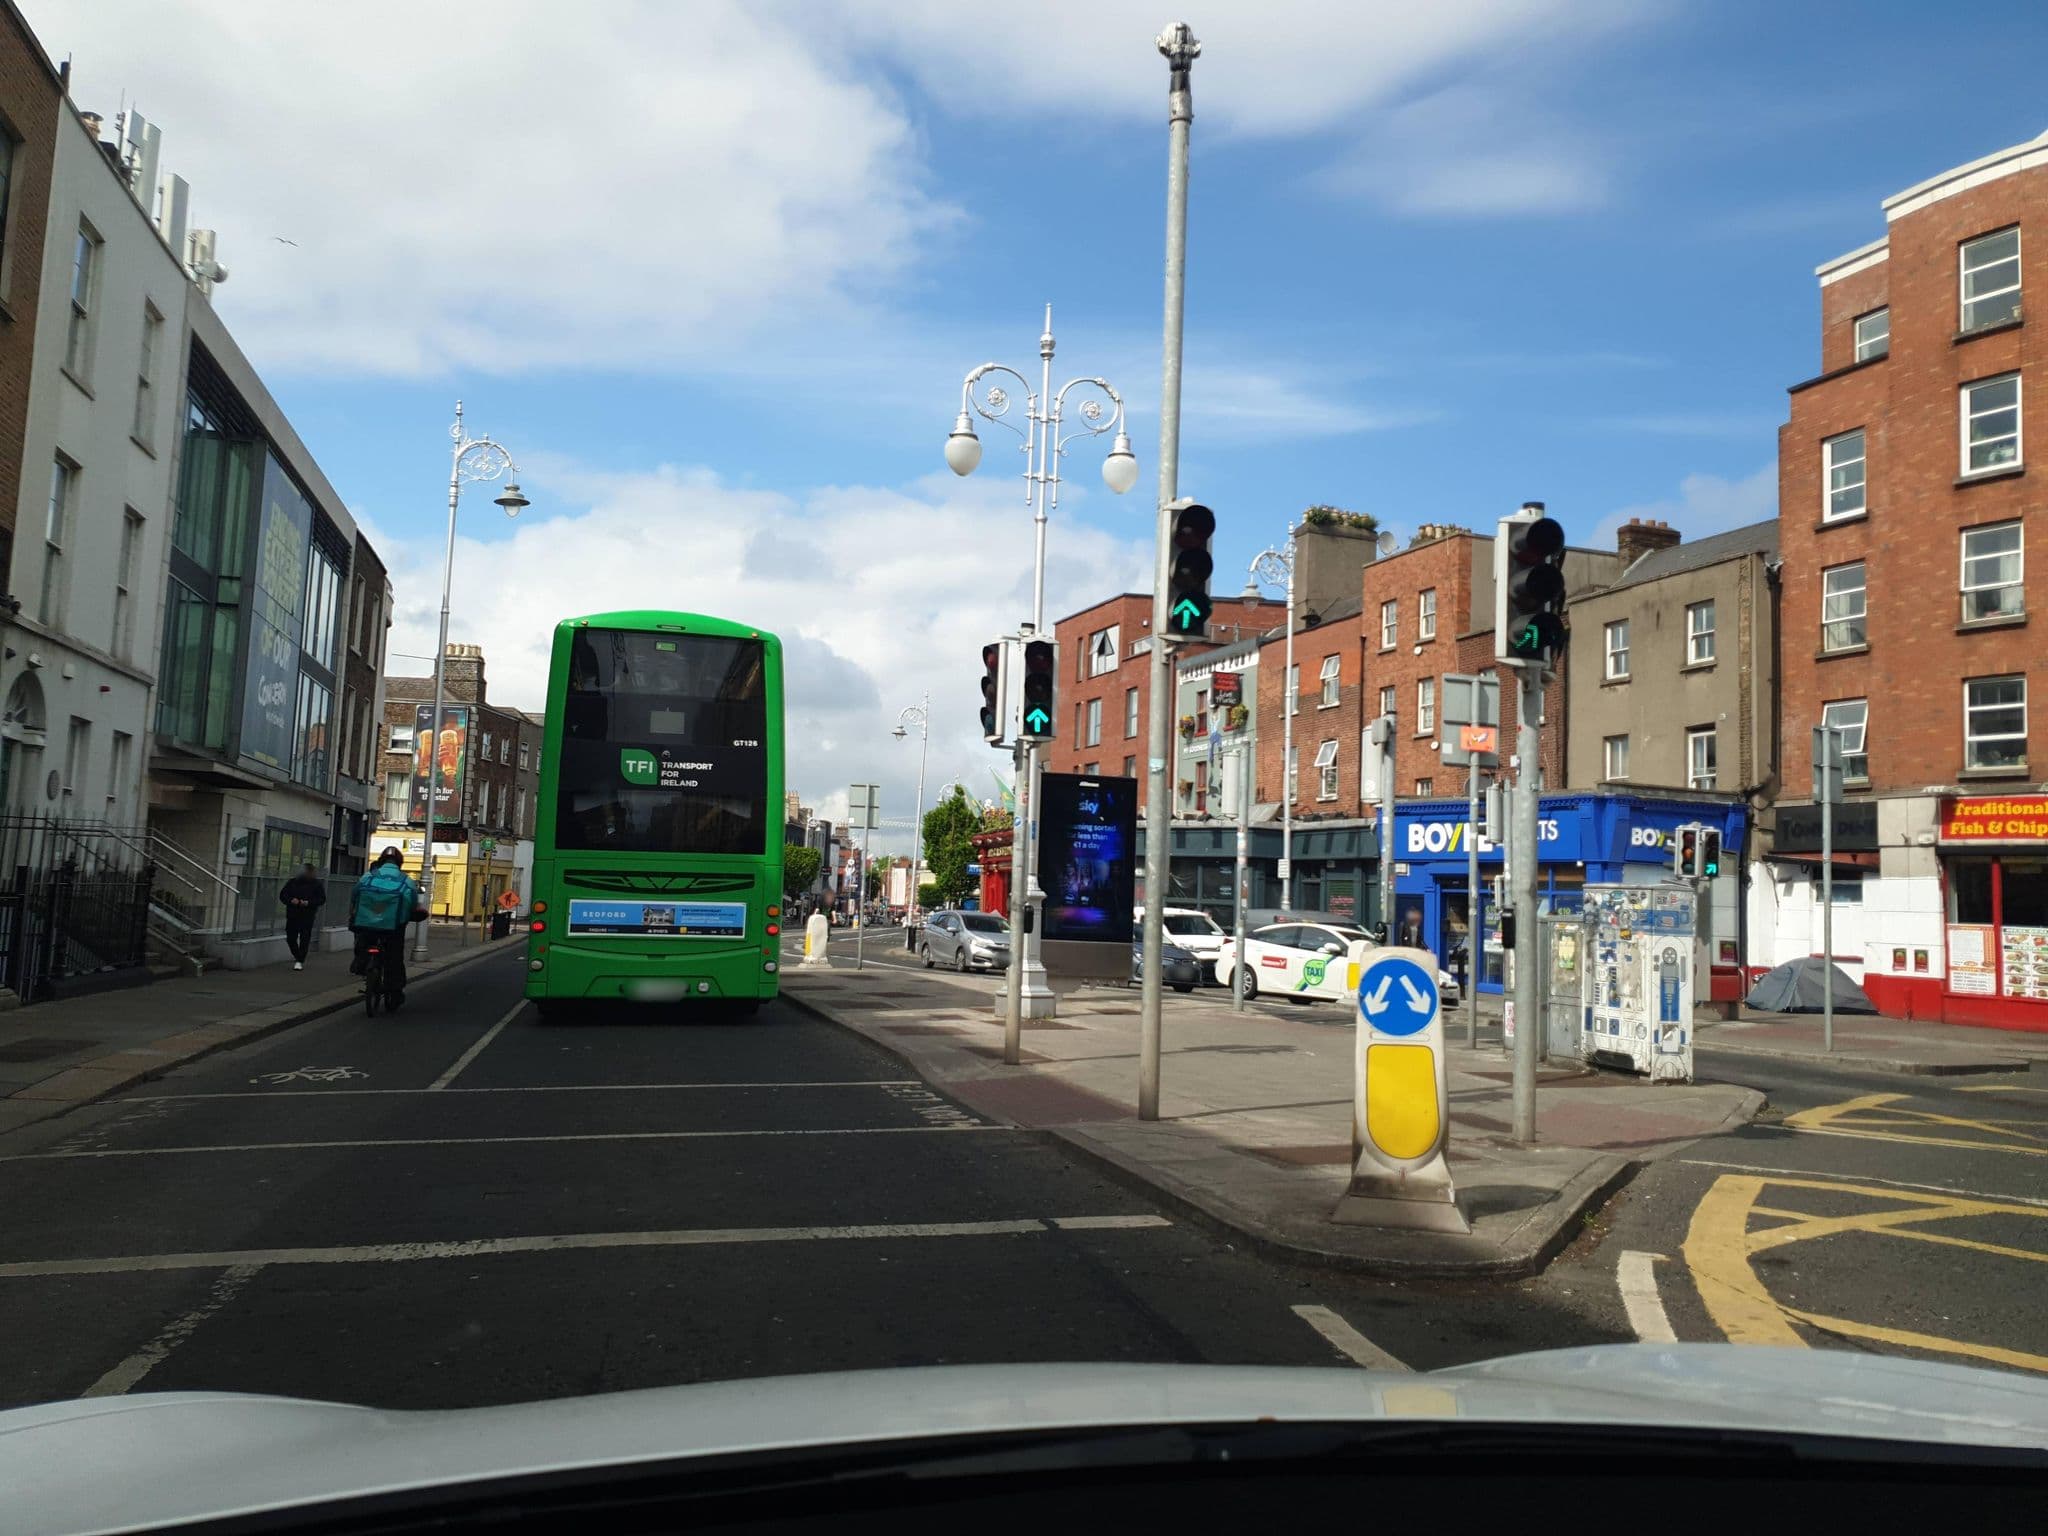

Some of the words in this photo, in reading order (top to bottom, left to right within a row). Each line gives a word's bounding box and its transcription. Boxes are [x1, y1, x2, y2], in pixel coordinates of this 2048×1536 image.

[626, 760, 653, 773] TFI
[661, 761, 713, 770] TRANSPORT
[661, 770, 679, 778] FOR
[660, 779, 698, 787] IRELAND
[1079, 800, 1099, 814] sky
[1093, 824, 1117, 832] sorted
[1951, 821, 1984, 835] Fish
[1988, 821, 2003, 834] &
[1092, 832, 1108, 840] than
[1088, 842, 1101, 850] day
[1305, 966, 1324, 977] TAXI
